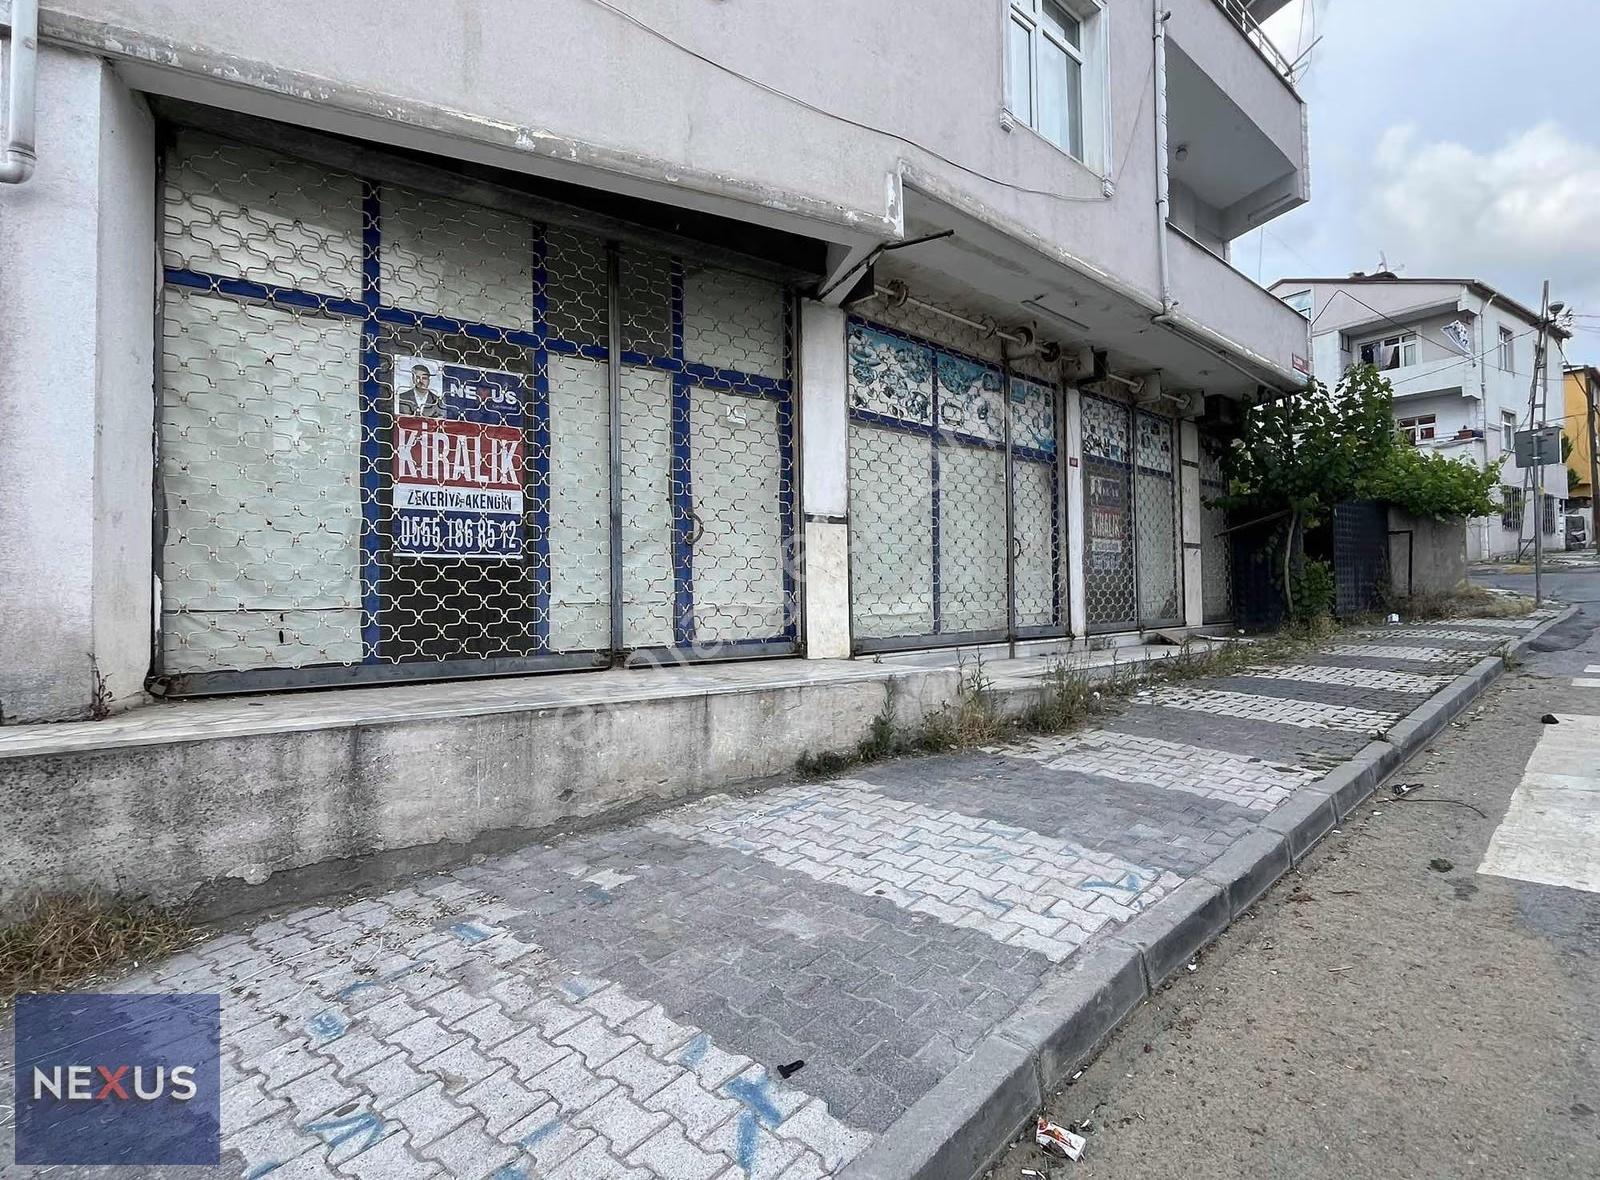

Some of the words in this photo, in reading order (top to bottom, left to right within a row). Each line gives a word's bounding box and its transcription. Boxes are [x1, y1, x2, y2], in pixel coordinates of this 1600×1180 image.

[398, 422, 520, 485] KİRALIK
[401, 516, 440, 547] 0555
[447, 518, 473, 548] 186
[477, 518, 495, 549] 85
[502, 520, 517, 549] 12
